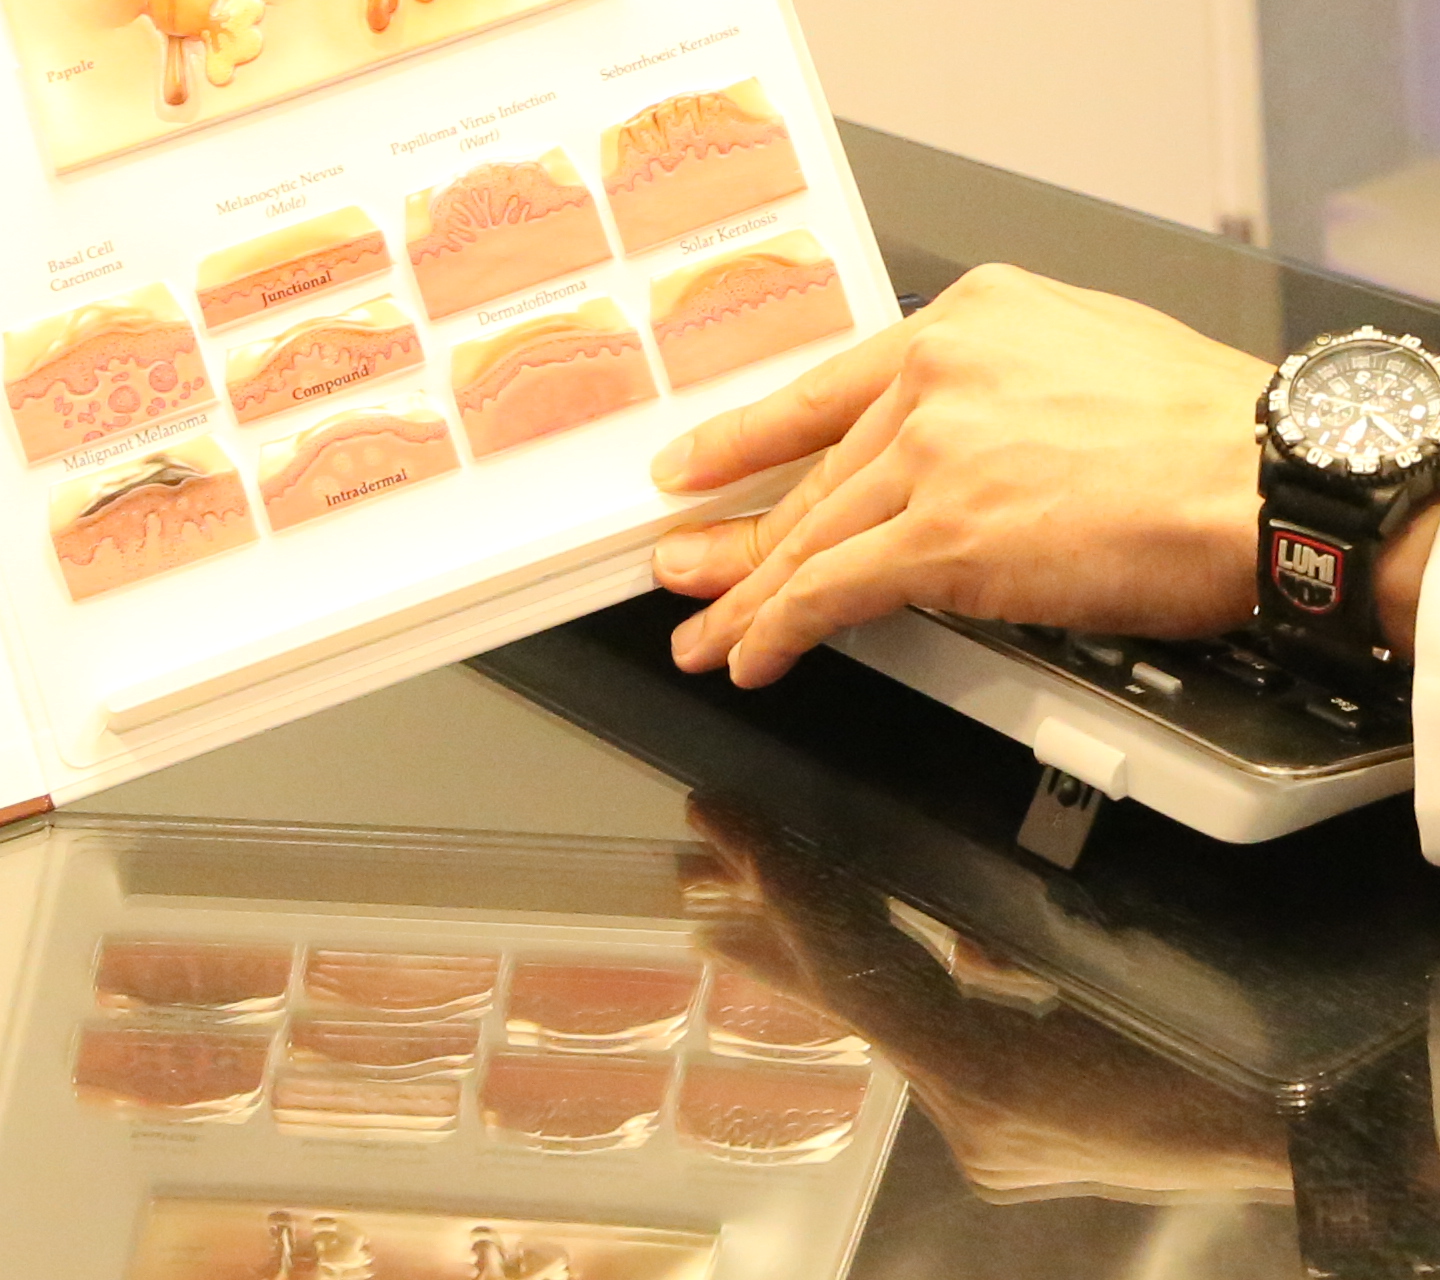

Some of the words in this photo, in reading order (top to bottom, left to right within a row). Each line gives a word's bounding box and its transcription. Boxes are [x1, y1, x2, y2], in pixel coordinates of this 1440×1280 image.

[46, 58, 95, 85] Papule
[599, 46, 678, 81] Seborrhoeic
[678, 23, 741, 55] Keratosis
[389, 126, 459, 156] Papilloma
[459, 110, 497, 132] Virus
[498, 90, 558, 120] Infection
[459, 128, 501, 153] (Wart)
[215, 179, 299, 216] Melanocytic
[299, 163, 345, 187] Nevus
[264, 194, 308, 219] (Mole)
[679, 234, 715, 256] Solar
[716, 210, 779, 243] Keratosis
[47, 250, 85, 274] Basal
[86, 239, 115, 261] Cell
[49, 260, 125, 293] Carcinoma
[260, 269, 334, 309] Junctional
[477, 278, 589, 327] Dermatofibroma
[291, 364, 370, 402] Compound
[61, 437, 135, 472] Malignant
[135, 412, 209, 449] Melanoma
[324, 468, 408, 509] Intradermal
[1277, 538, 1336, 584] LUMI
